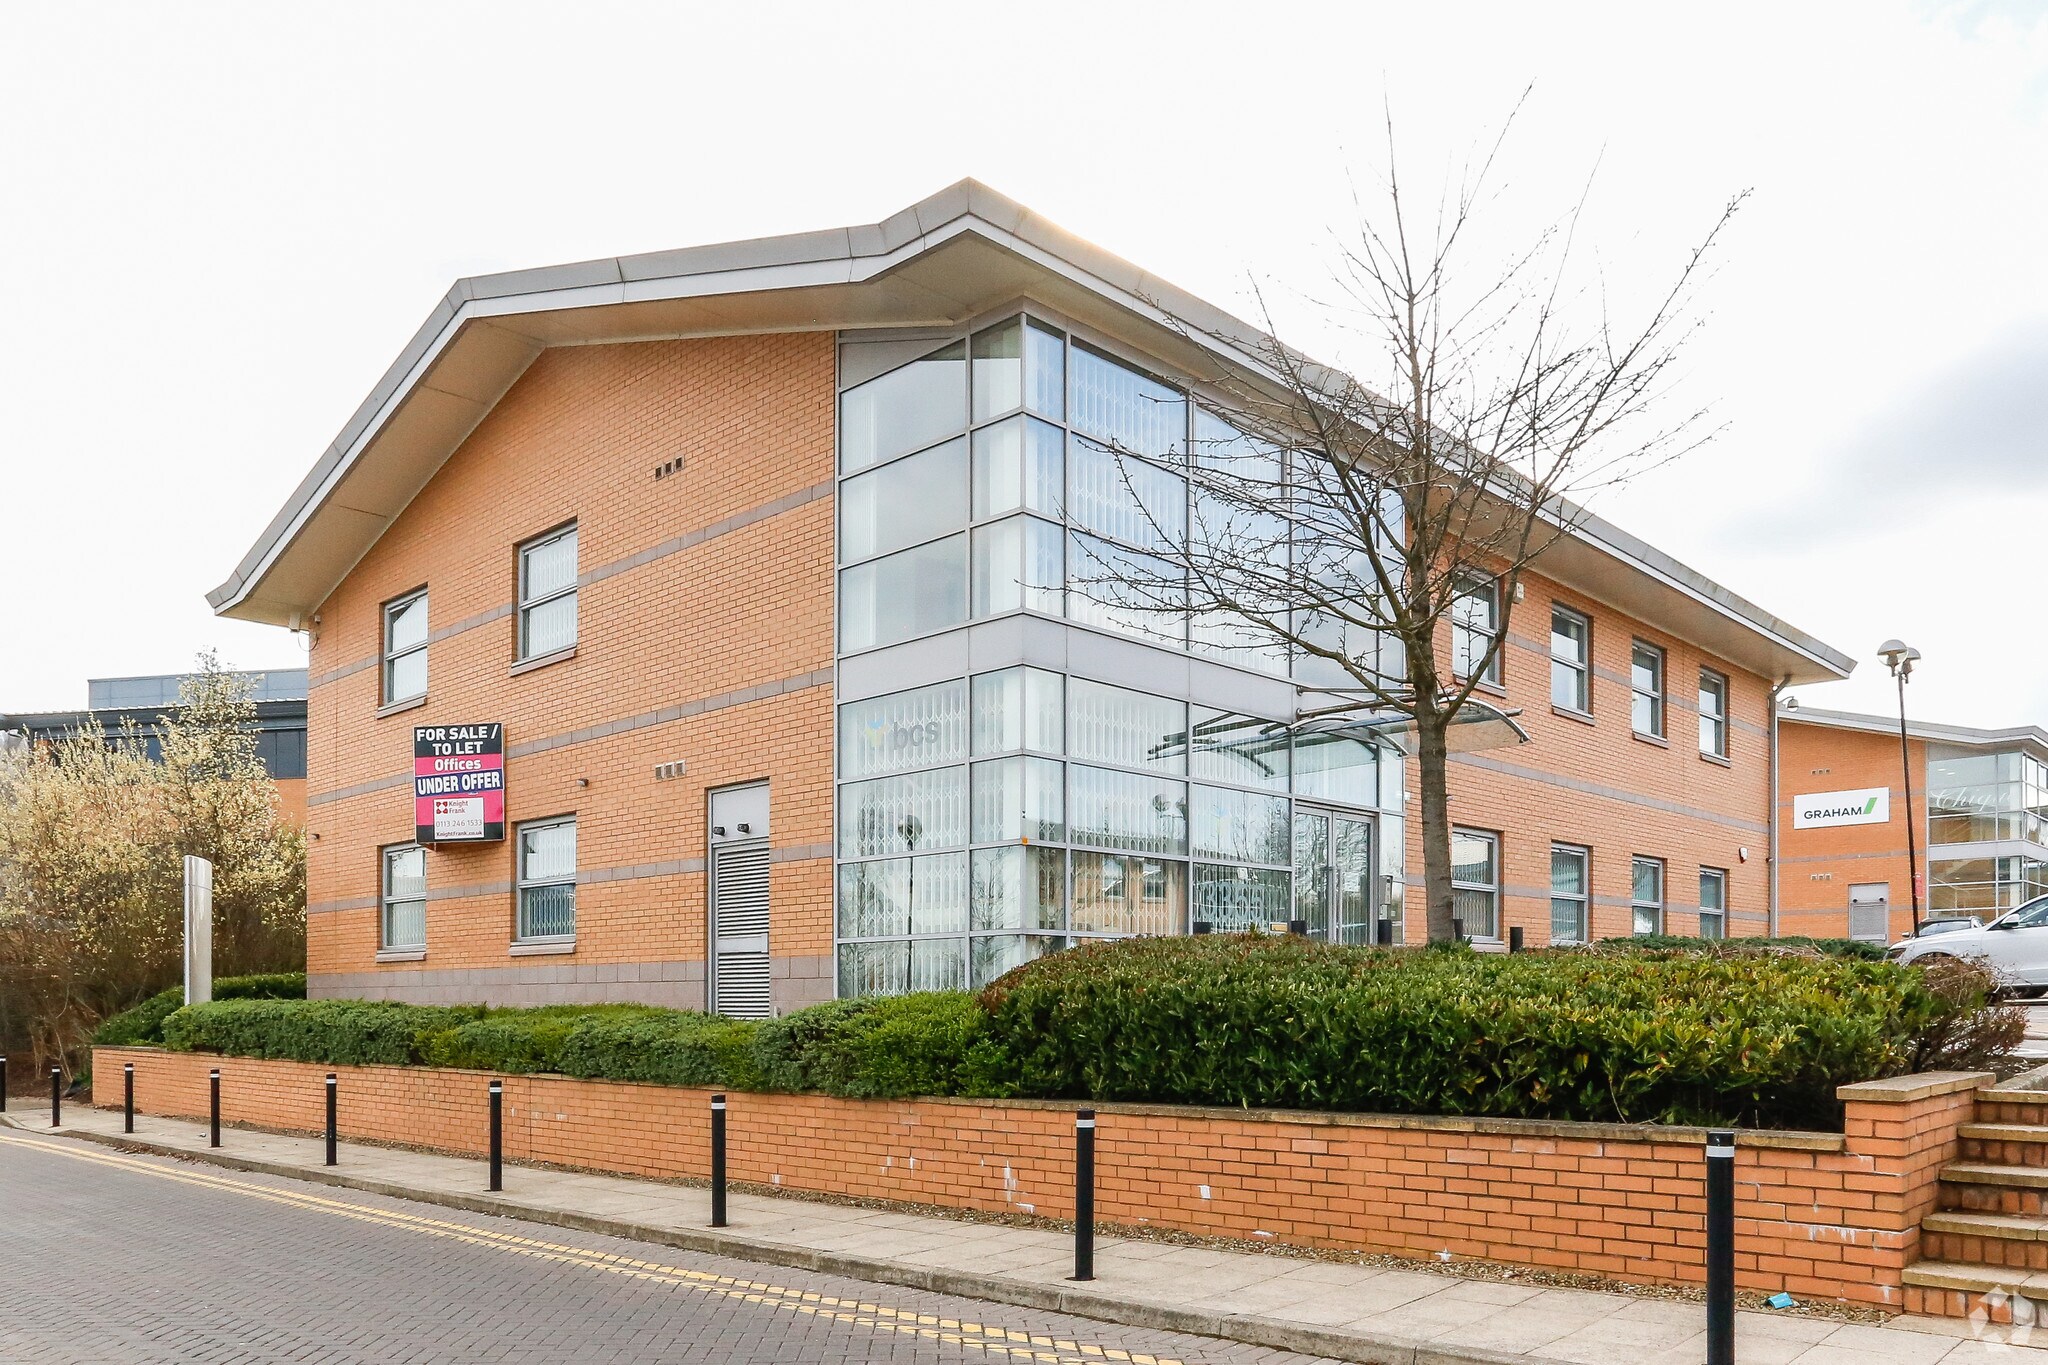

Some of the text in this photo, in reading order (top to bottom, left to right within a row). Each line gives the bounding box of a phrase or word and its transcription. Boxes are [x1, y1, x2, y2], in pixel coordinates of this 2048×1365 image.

[416, 724, 499, 742] FOR SALE /
[432, 741, 483, 755] TO LET
[434, 758, 481, 771] Offices
[417, 771, 500, 795] UNDER OFFER
[449, 800, 468, 808] Knight
[1804, 806, 1862, 820] GRAHAM
[436, 820, 450, 828] 0113
[467, 819, 482, 827] 1533
